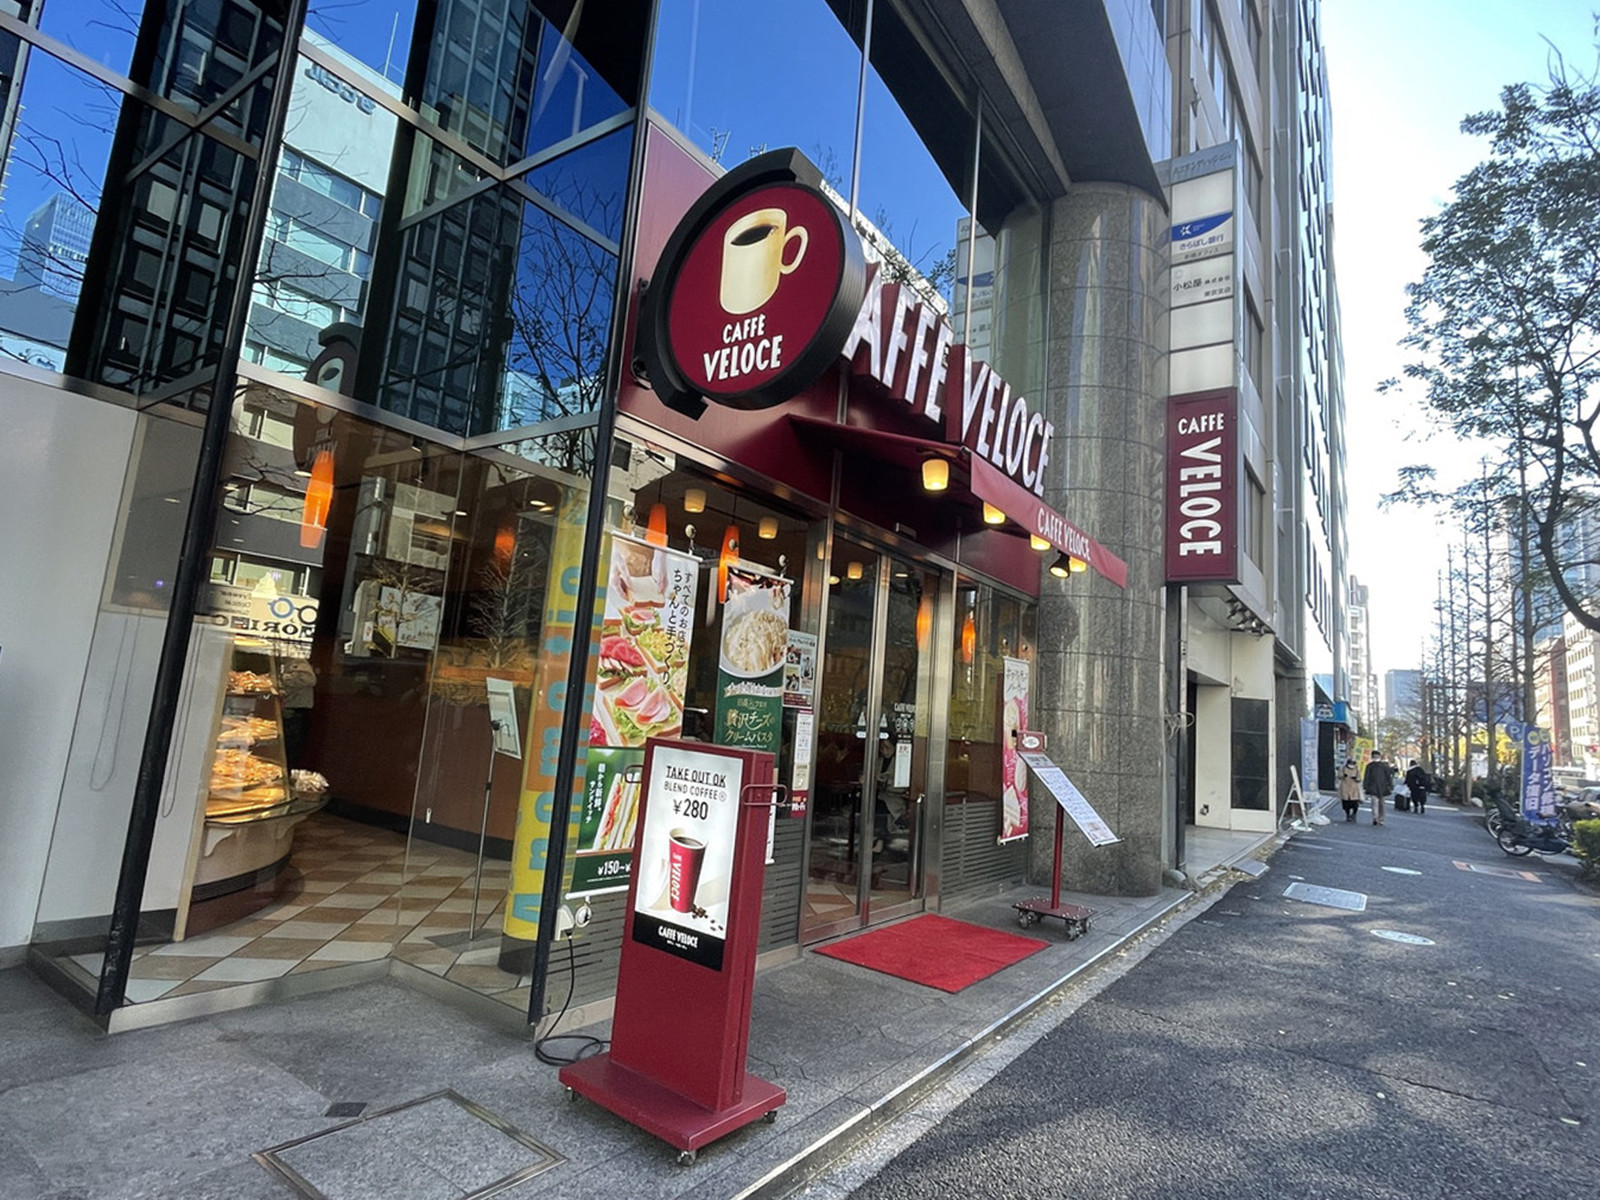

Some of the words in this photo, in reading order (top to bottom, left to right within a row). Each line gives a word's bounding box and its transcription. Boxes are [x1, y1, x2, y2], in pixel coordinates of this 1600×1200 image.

[703, 335, 783, 383] VELOCE
[842, 262, 955, 424] AFFE
[962, 345, 1054, 497] VELOCE
[1179, 437, 1222, 556] VELOCE
[1063, 523, 1091, 562] VELOCE
[661, 568, 683, 690] ちゃんと手づくり。
[676, 572, 693, 661] すべてのお店で、
[664, 781, 688, 794] BLEND
[690, 785, 718, 800] COFFEE
[666, 765, 690, 782] TAKE
[691, 770, 711, 785] OUT
[713, 773, 727, 788] OK
[673, 798, 709, 820] ¥280
[676, 929, 699, 948] VELOCE
